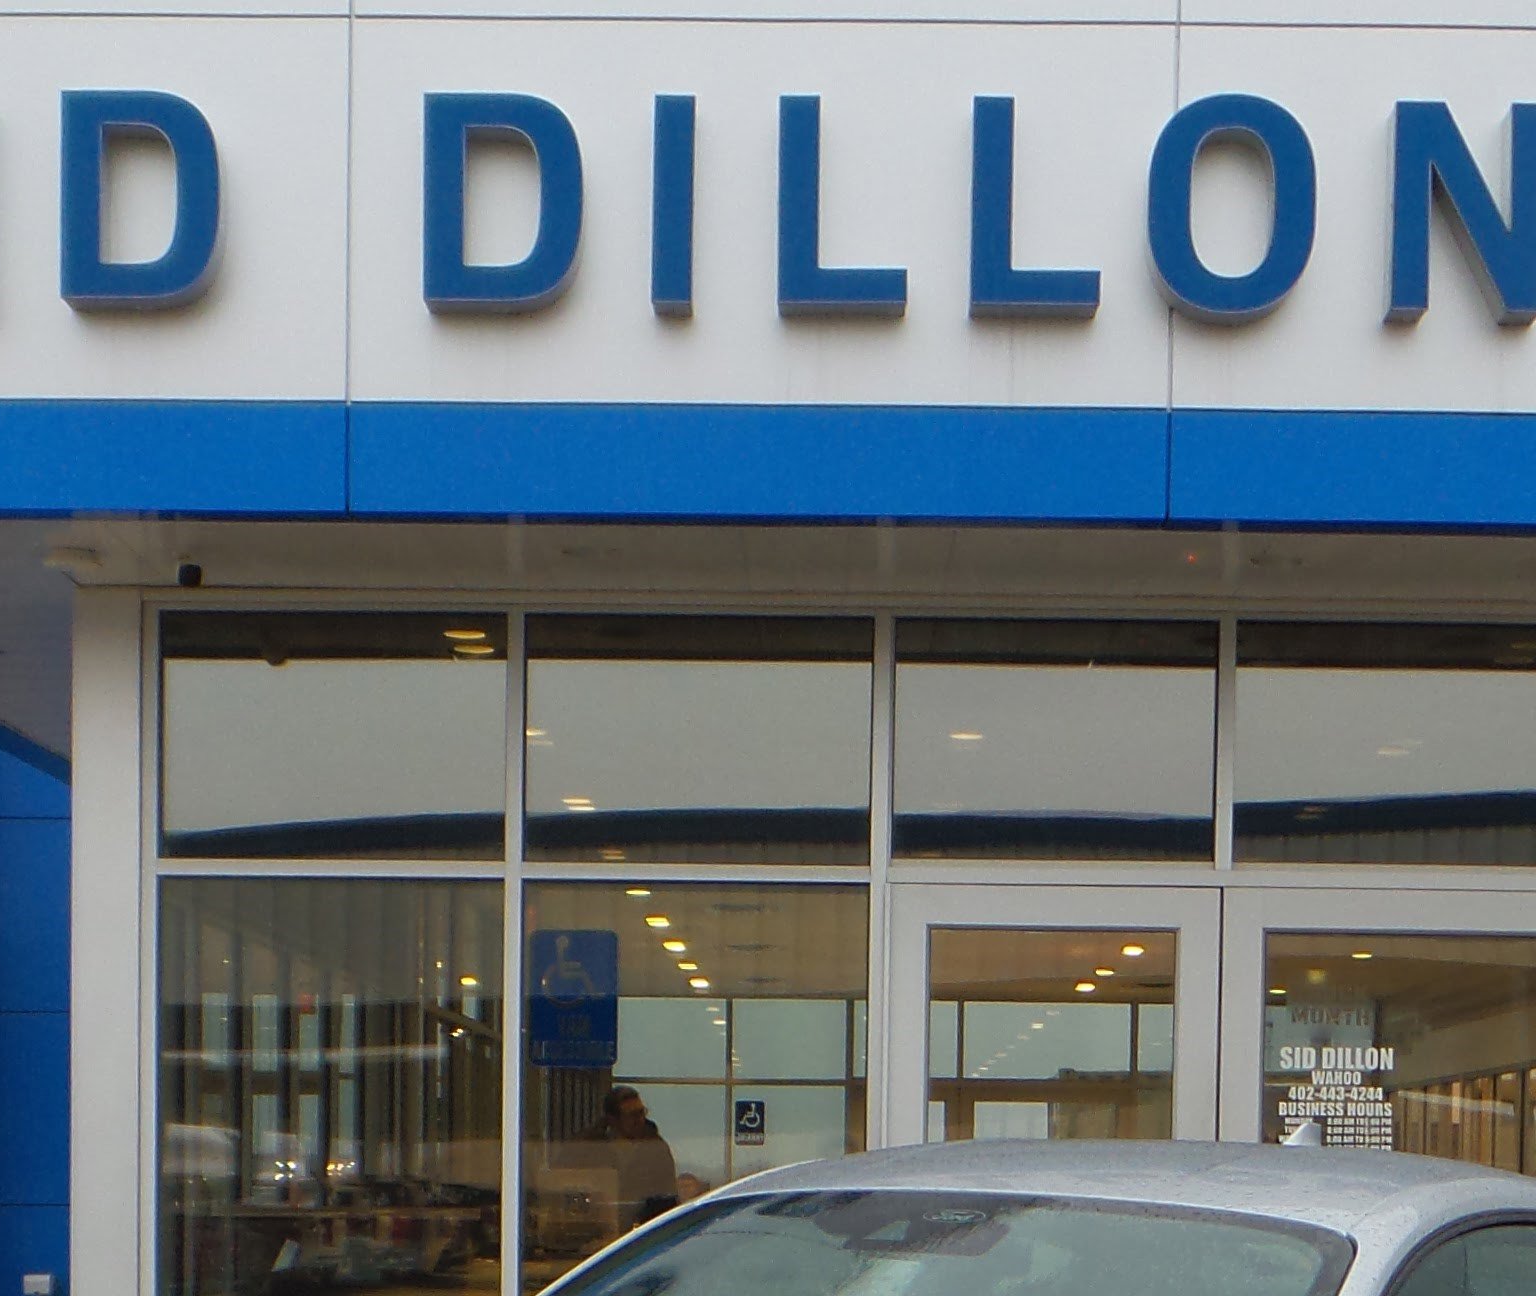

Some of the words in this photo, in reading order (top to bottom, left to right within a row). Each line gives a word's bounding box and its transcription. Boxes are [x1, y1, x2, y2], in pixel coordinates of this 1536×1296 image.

[1280, 1046, 1316, 1070] SID
[1321, 1047, 1394, 1071] DILLON
[1311, 1070, 1362, 1085] WAHOO
[1288, 1086, 1384, 1101] 402-443-4244
[1278, 1101, 1344, 1117] BUSINESS
[1347, 1102, 1393, 1117] HOURS
